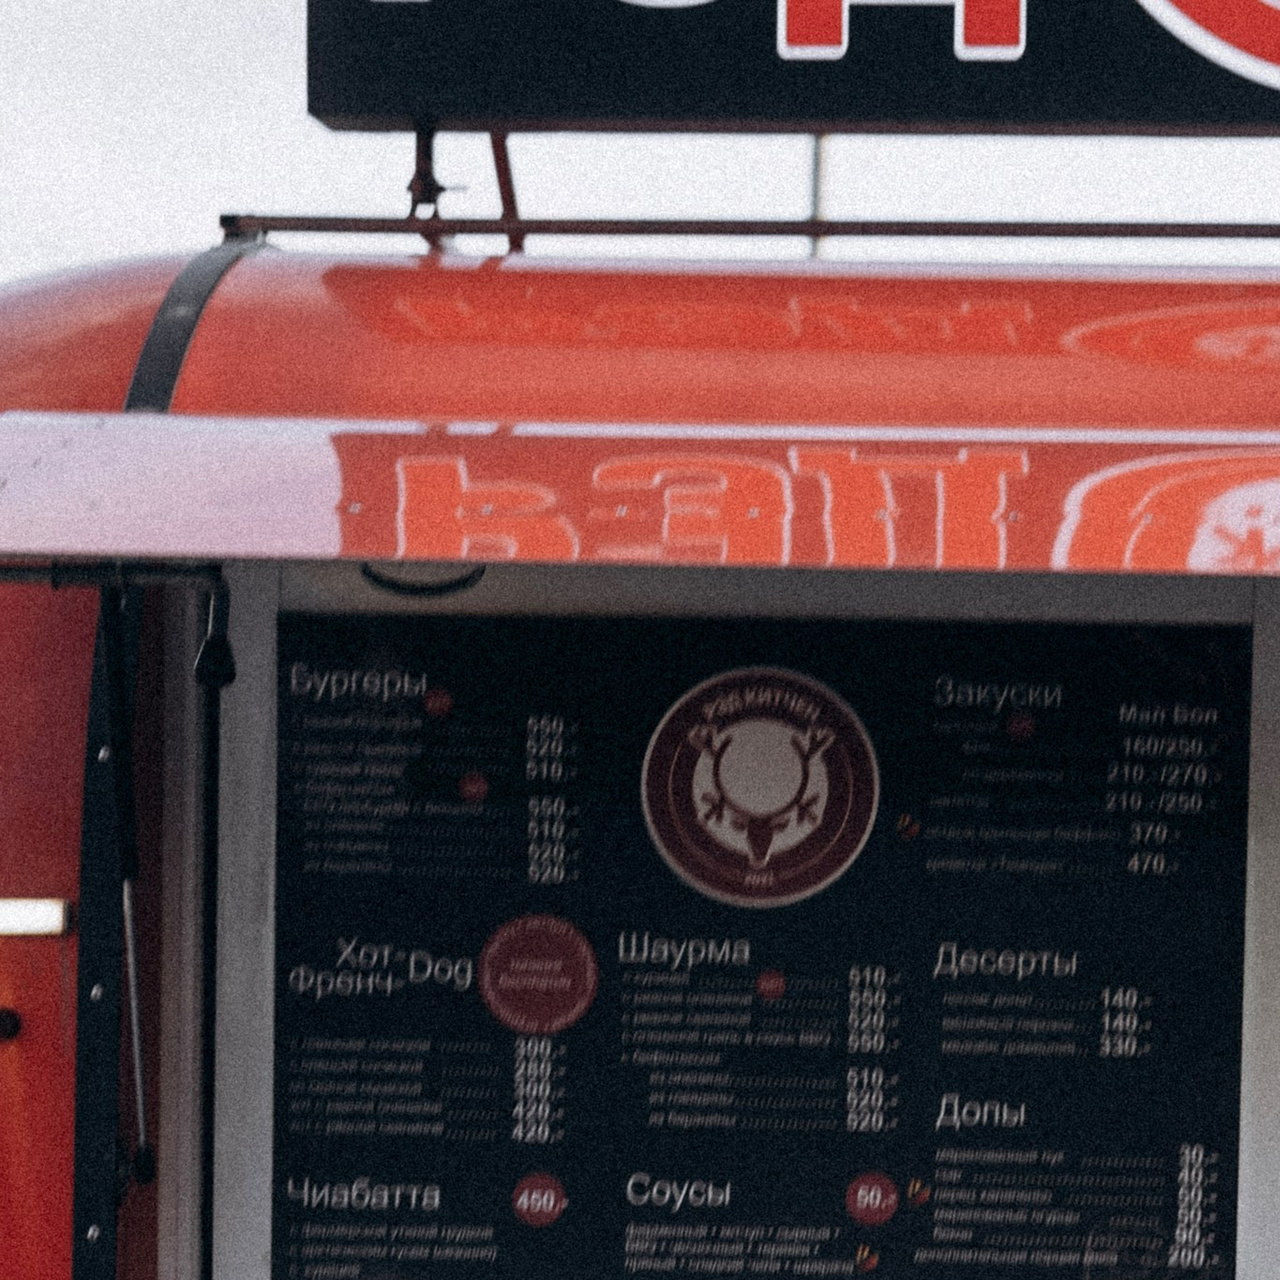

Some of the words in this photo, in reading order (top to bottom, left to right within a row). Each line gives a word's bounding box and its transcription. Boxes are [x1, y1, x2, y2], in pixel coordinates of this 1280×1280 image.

[289, 661, 429, 702] Бургеры
[935, 673, 1064, 714] Закуски
[408, 949, 473, 992] Dog
[617, 930, 751, 971] Шаурма
[932, 940, 1079, 982] Десерты
[934, 1091, 1027, 1132] Допы
[286, 1175, 443, 1212] Чиабатта
[625, 1170, 733, 1215] Соусы
